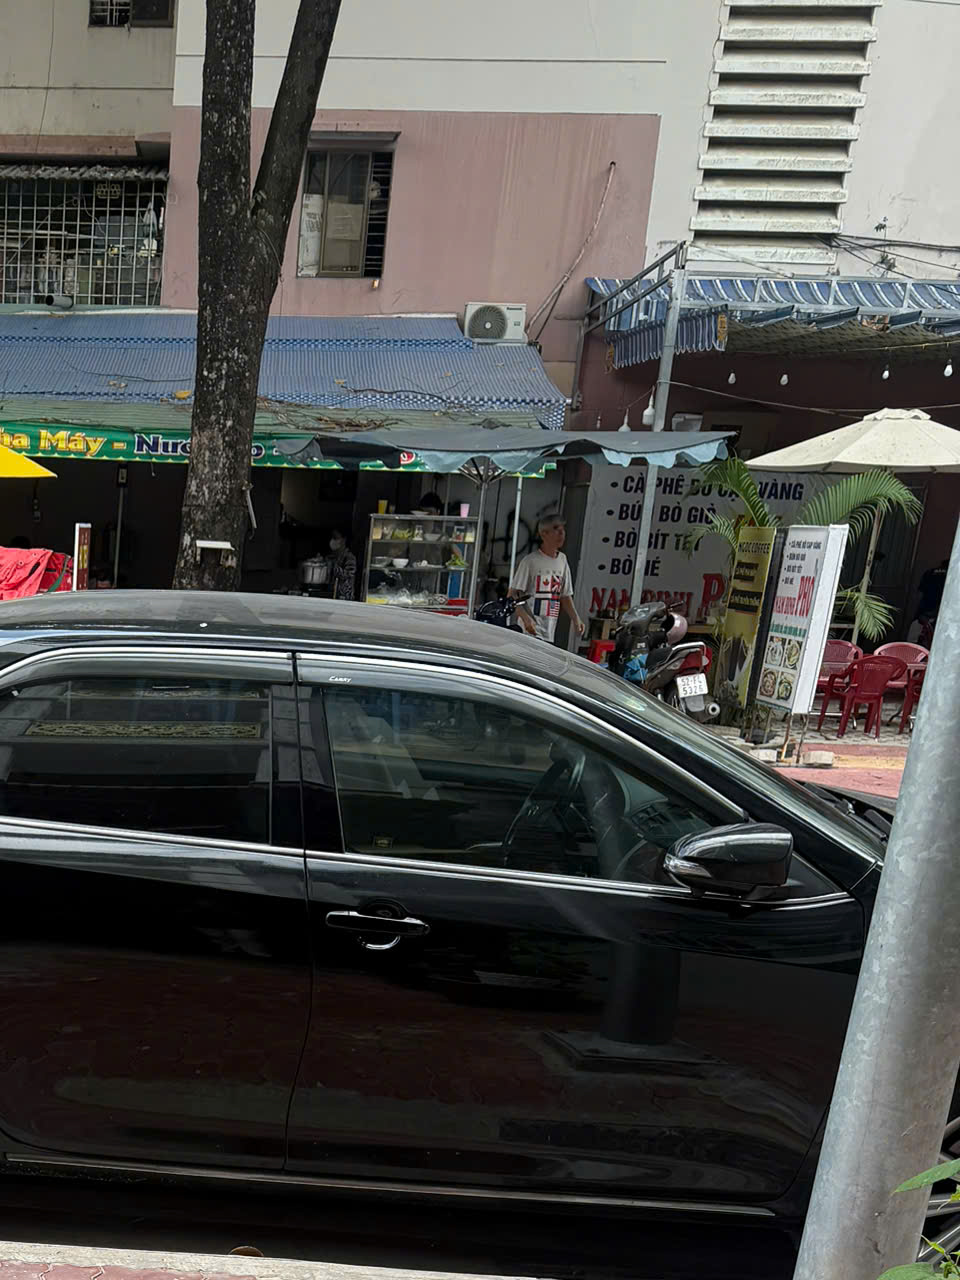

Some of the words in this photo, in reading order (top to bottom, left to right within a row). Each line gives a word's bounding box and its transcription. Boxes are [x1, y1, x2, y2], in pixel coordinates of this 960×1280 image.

[39, 429, 107, 456] Máy
[623, 472, 644, 493] CÀ
[758, 478, 804, 500] VÀNG
[618, 500, 642, 521] BÚ
[658, 501, 681, 523] BÒ
[613, 527, 637, 549] BÒ
[609, 554, 633, 576] BÒ
